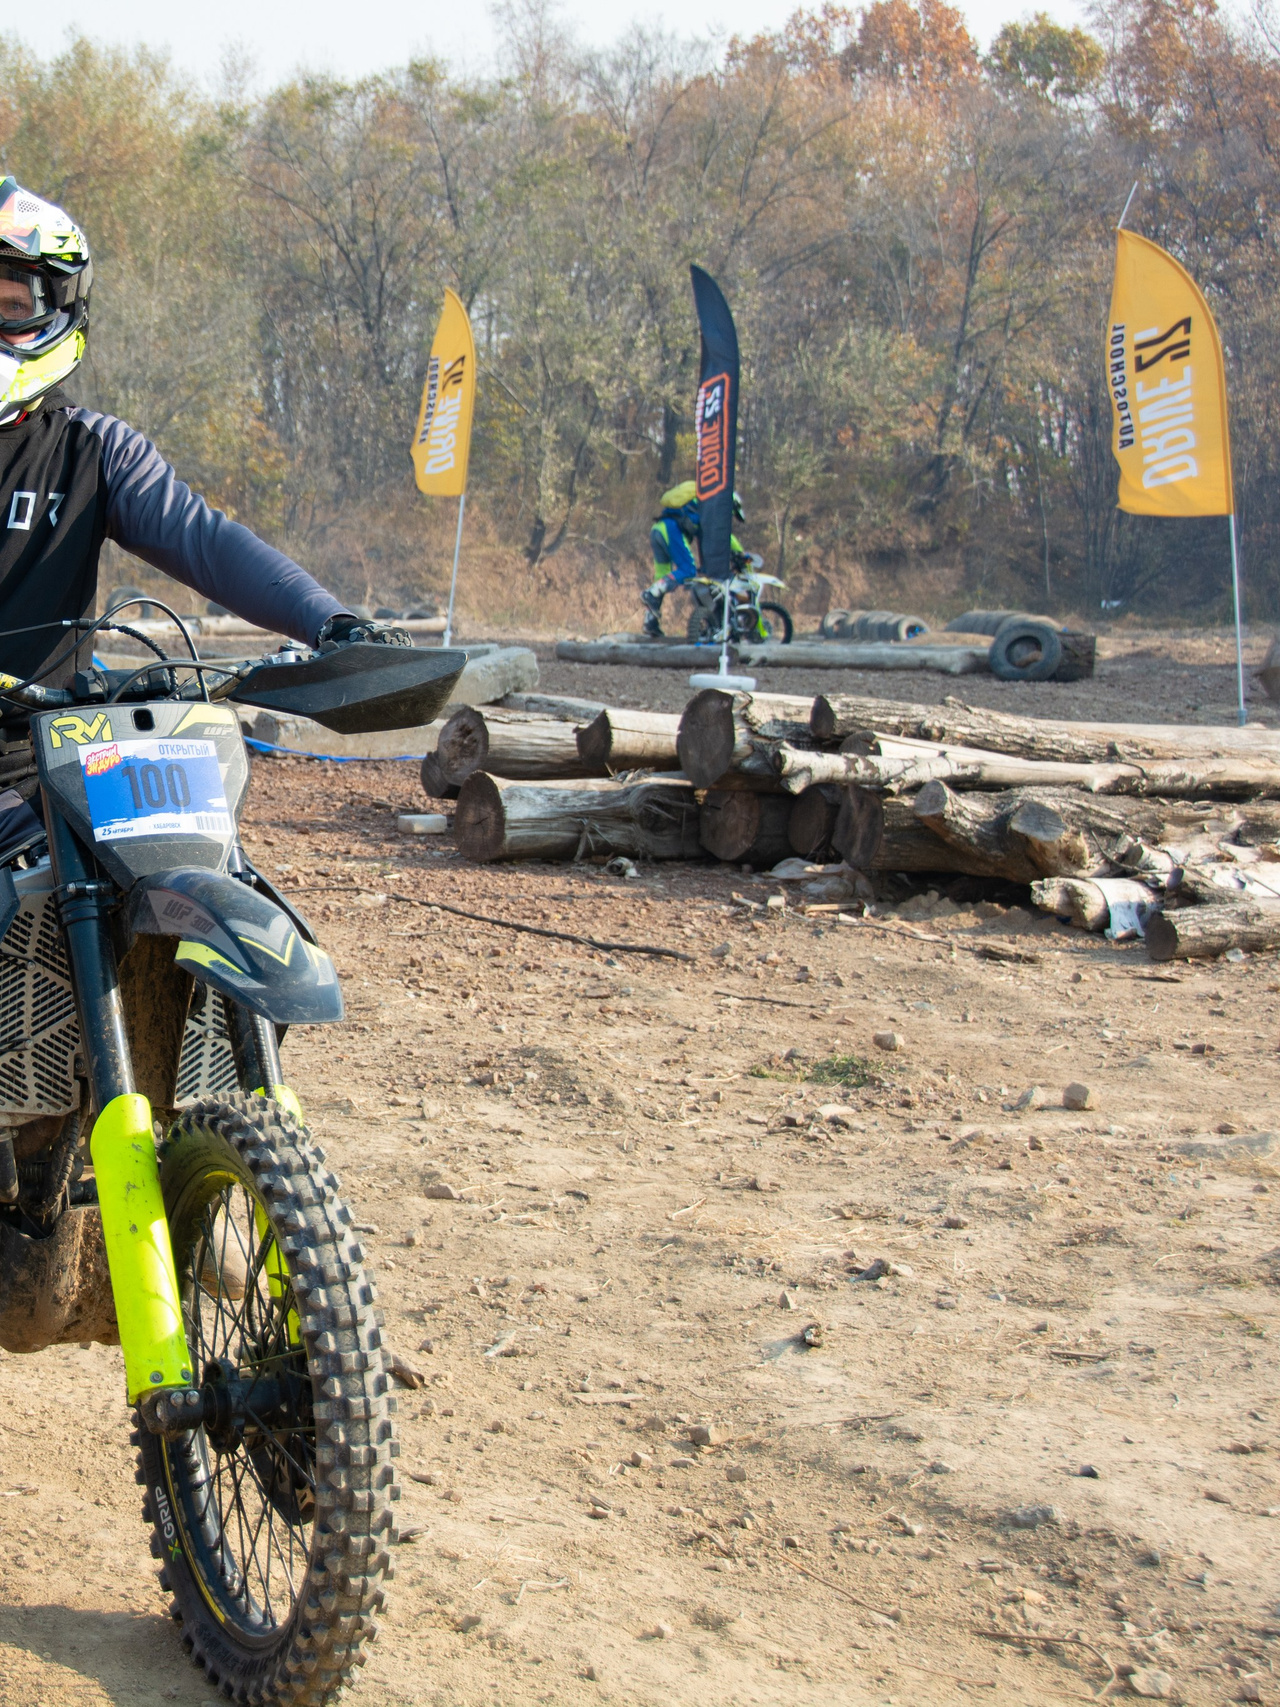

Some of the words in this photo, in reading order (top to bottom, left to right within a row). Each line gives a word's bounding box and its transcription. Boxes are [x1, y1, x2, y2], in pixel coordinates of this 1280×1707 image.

[158, 743, 210, 756] ОТКРЫТЫЙ
[121, 763, 192, 809] 100
[101, 827, 112, 836] 25
